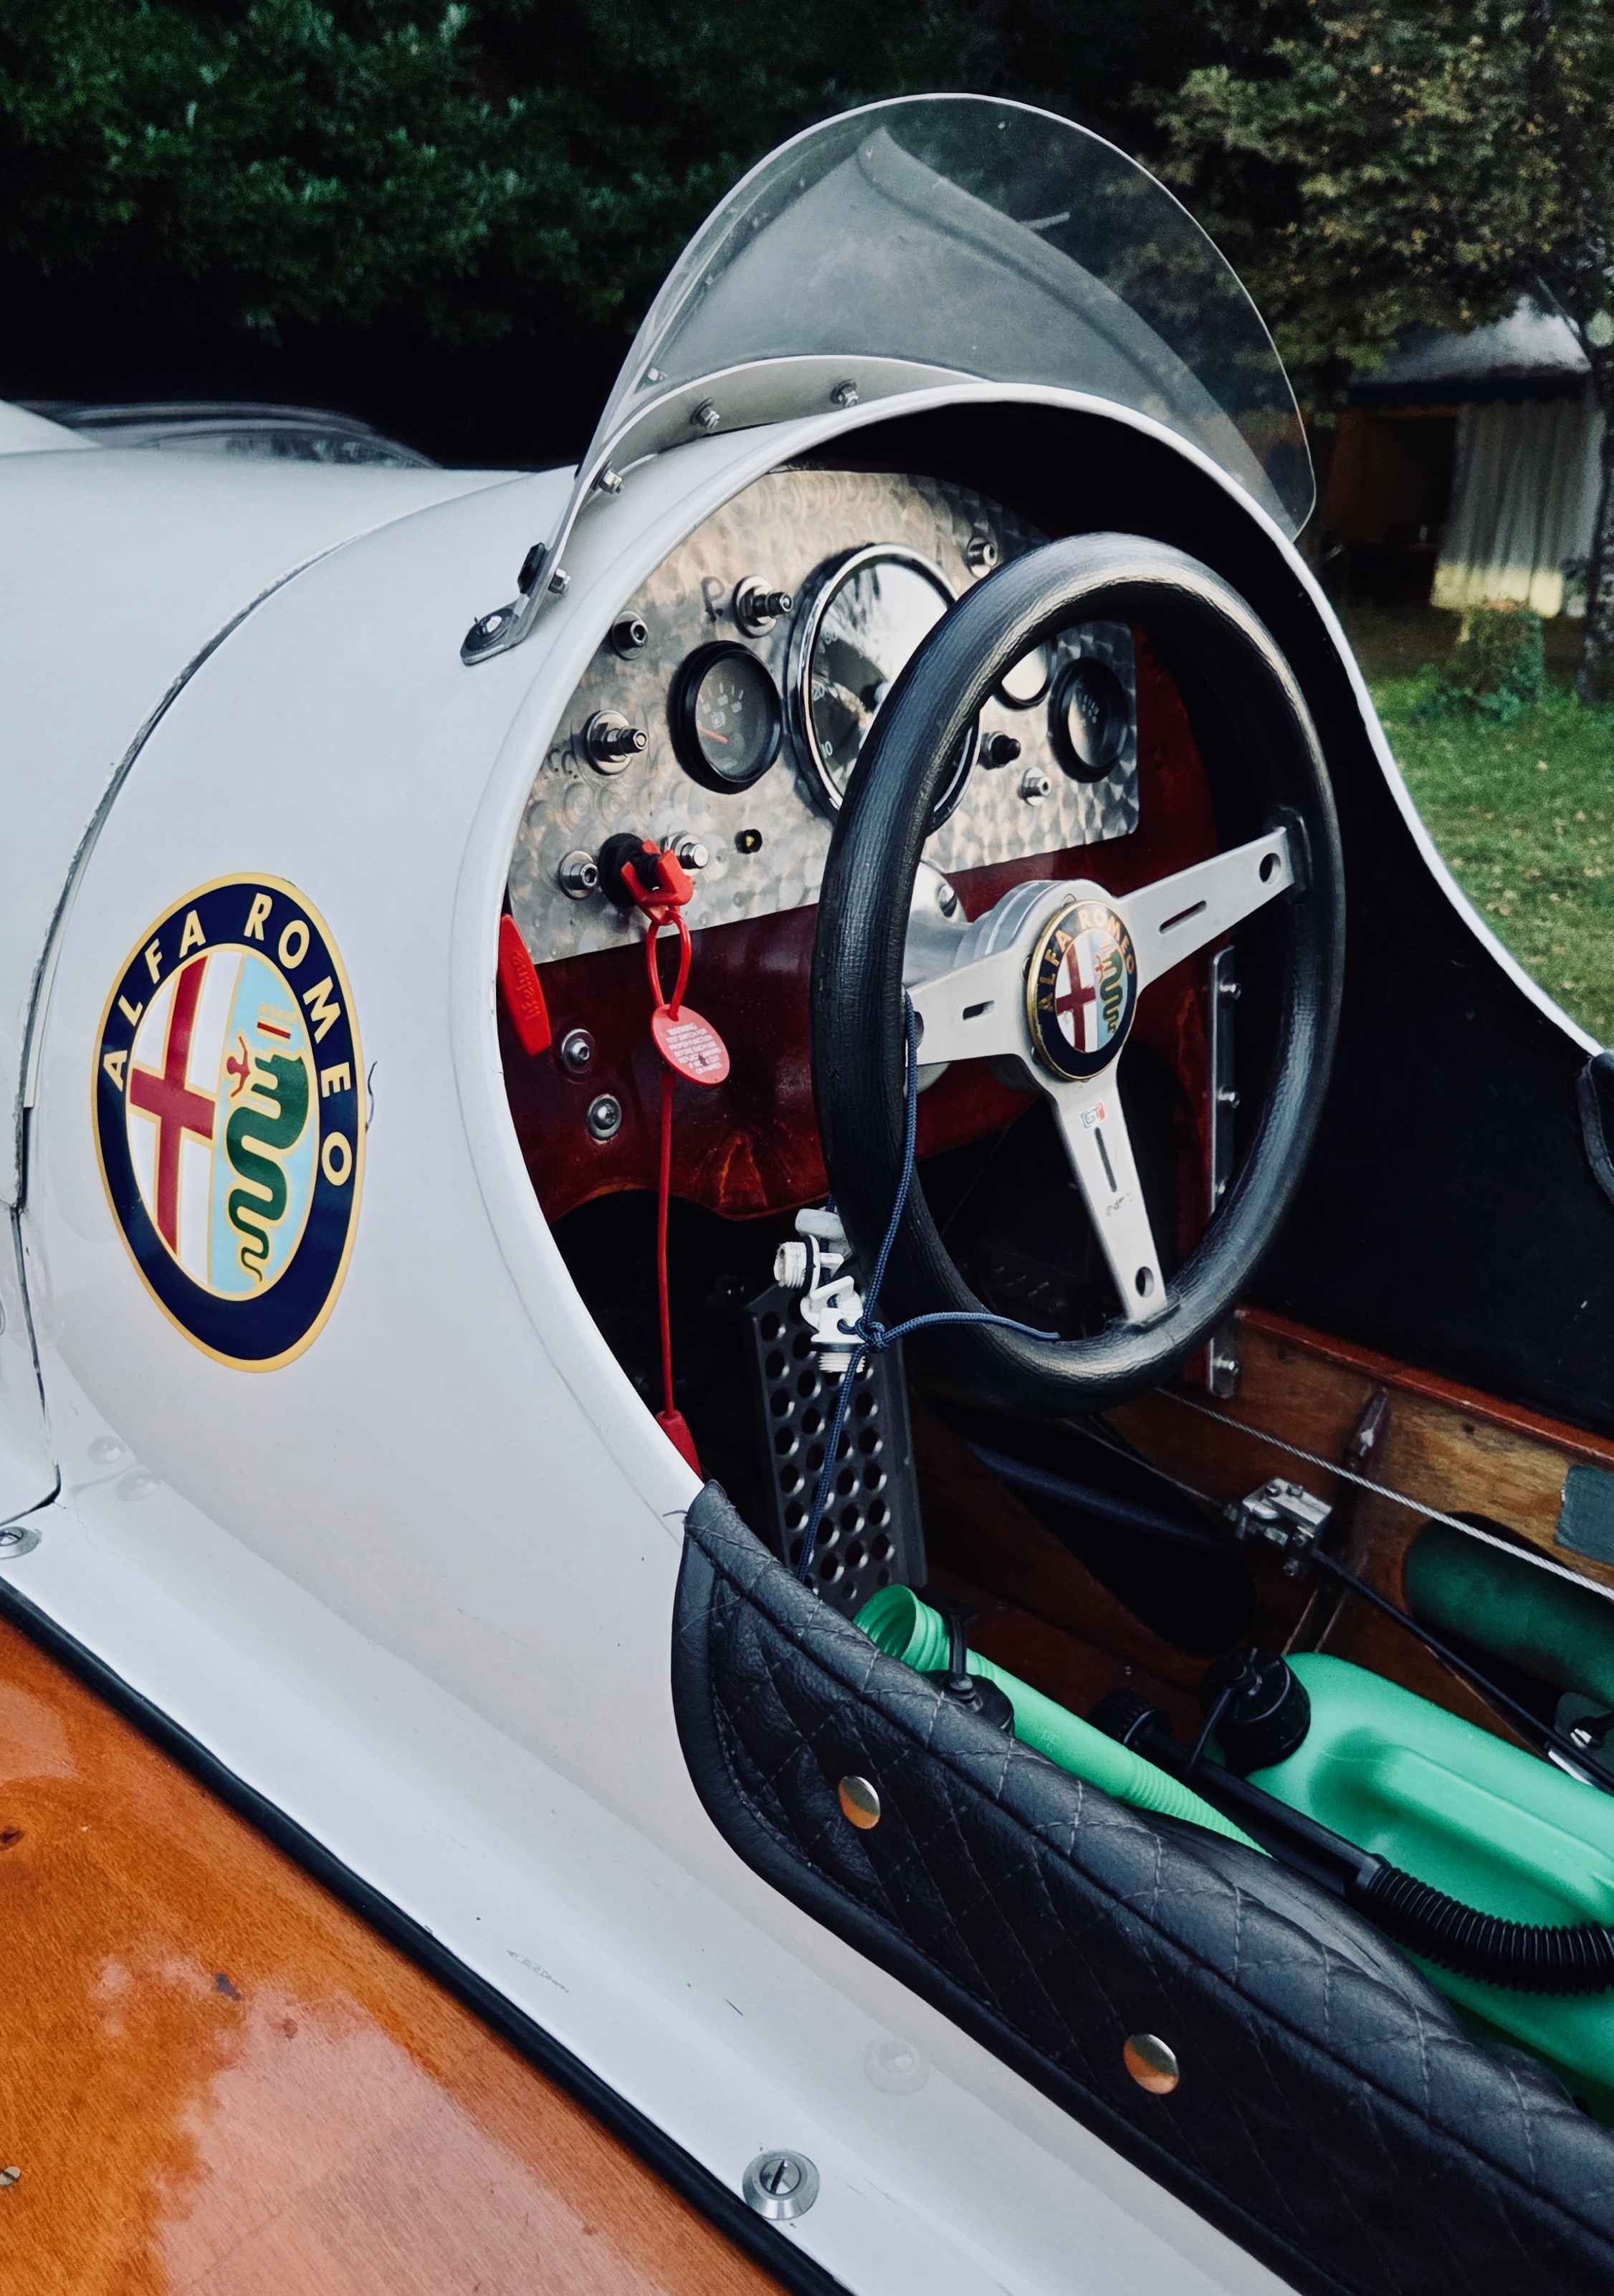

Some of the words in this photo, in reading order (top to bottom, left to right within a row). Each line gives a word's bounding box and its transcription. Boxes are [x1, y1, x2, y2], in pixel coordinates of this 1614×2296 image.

[812, 686, 825, 702] 20
[821, 740, 834, 759] 10
[1038, 929, 1073, 1011] ALFA
[1076, 907, 1135, 975] ROMEO
[103, 910, 206, 1093] ALFA
[243, 892, 353, 1186] ROMEO
